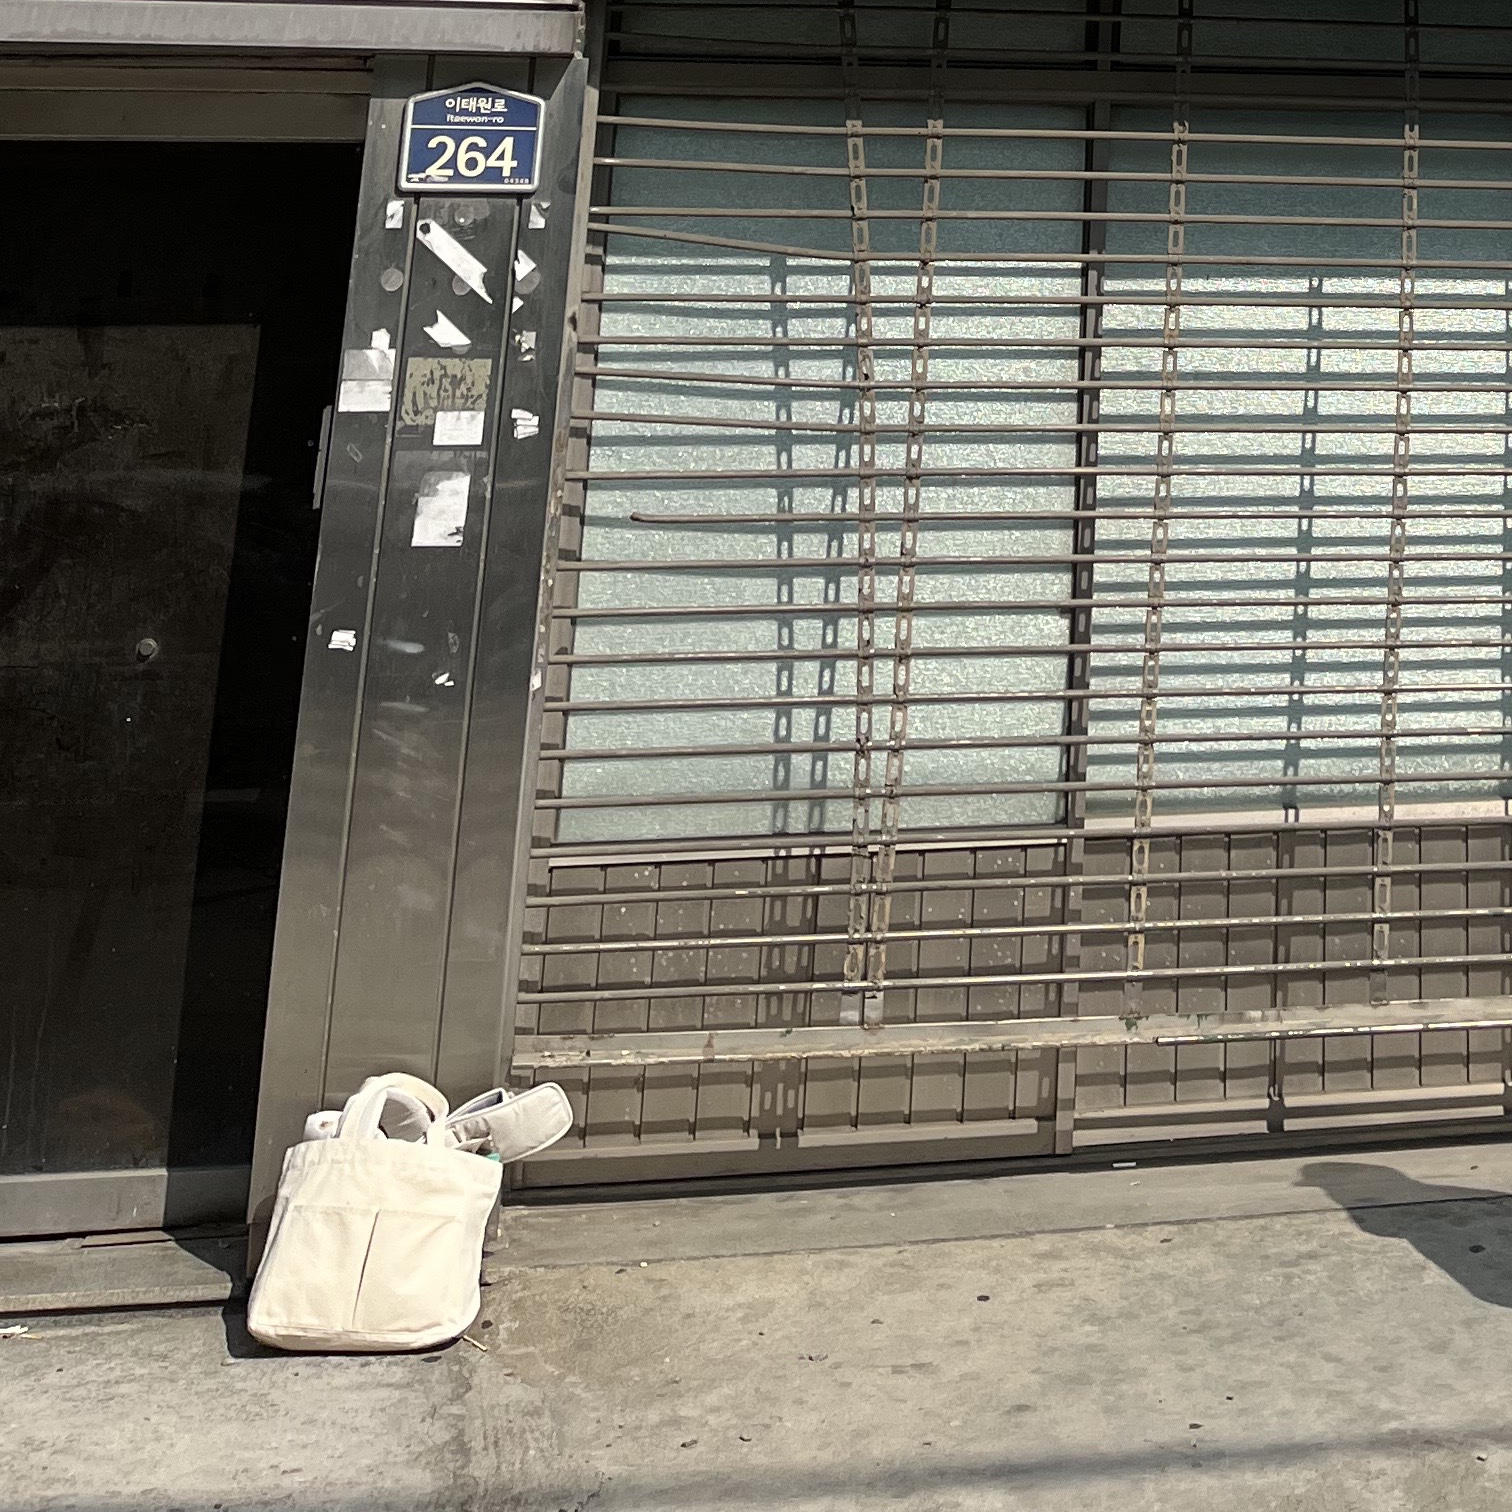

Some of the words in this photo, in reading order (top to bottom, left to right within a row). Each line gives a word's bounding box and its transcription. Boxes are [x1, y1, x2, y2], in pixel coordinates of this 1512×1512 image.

[445, 96, 508, 114] 이태원로
[446, 113, 505, 124] Itaewon-ro
[425, 135, 518, 178] 264
